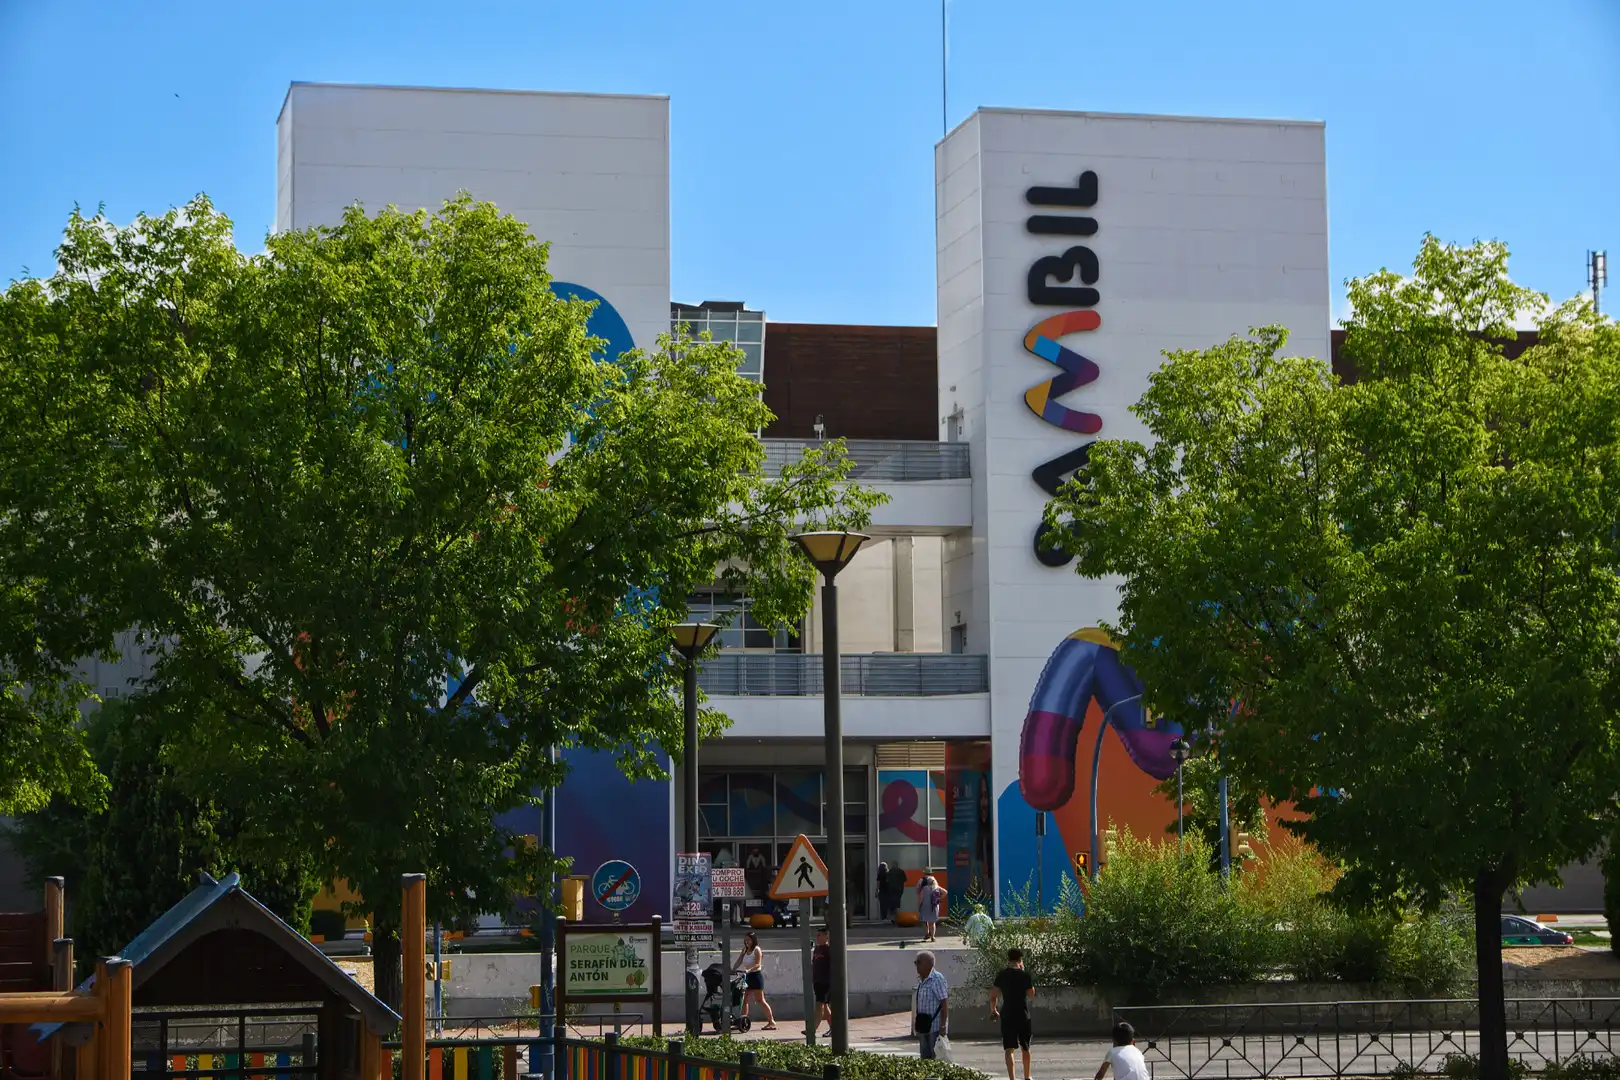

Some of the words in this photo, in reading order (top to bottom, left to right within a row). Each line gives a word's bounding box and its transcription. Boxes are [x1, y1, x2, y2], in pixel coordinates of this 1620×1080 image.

[678, 856, 707, 865] DINO
[570, 944, 610, 954] PARQUE
[570, 957, 617, 969] SERAFÍN
[620, 958, 645, 968] DIEZ
[570, 969, 609, 982] ANTÓN
